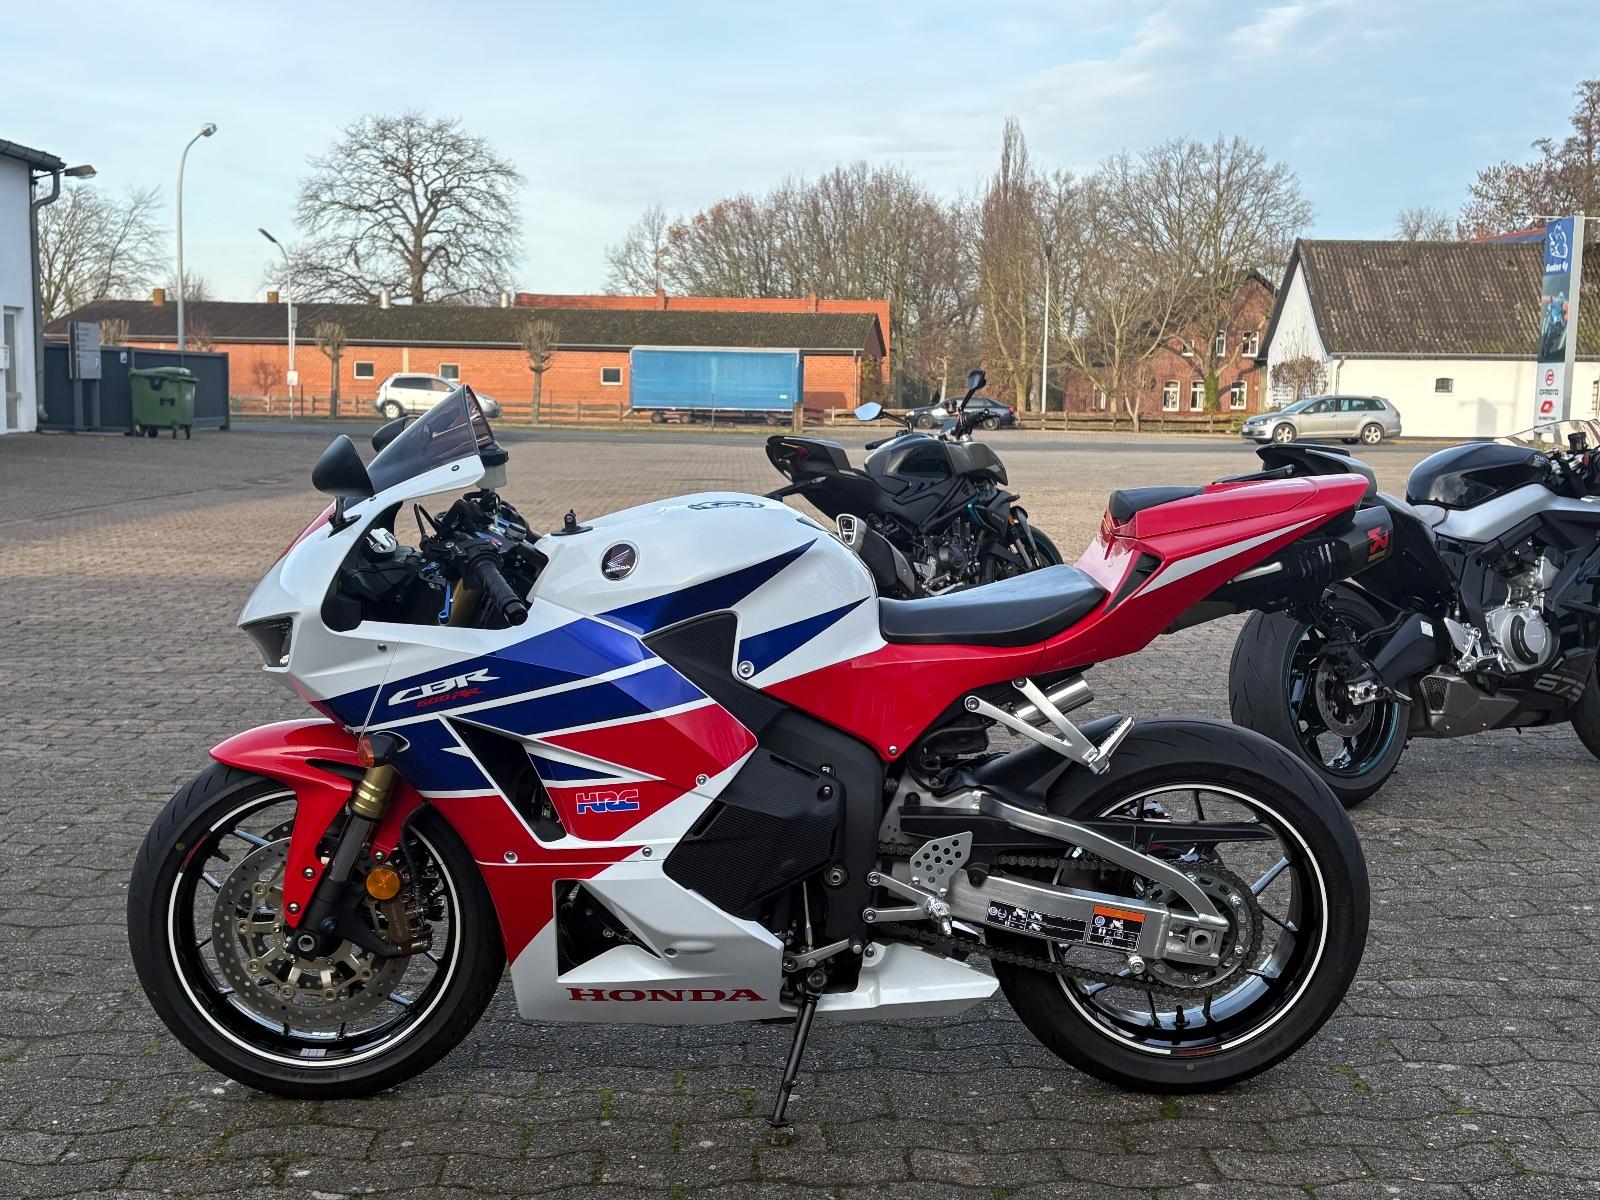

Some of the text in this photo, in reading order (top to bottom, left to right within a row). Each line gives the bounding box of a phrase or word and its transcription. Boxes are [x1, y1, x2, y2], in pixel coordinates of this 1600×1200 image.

[605, 564, 631, 573] HONDA
[388, 667, 501, 707] CBR
[575, 788, 640, 815] HRC
[566, 987, 768, 1002] HONDA
